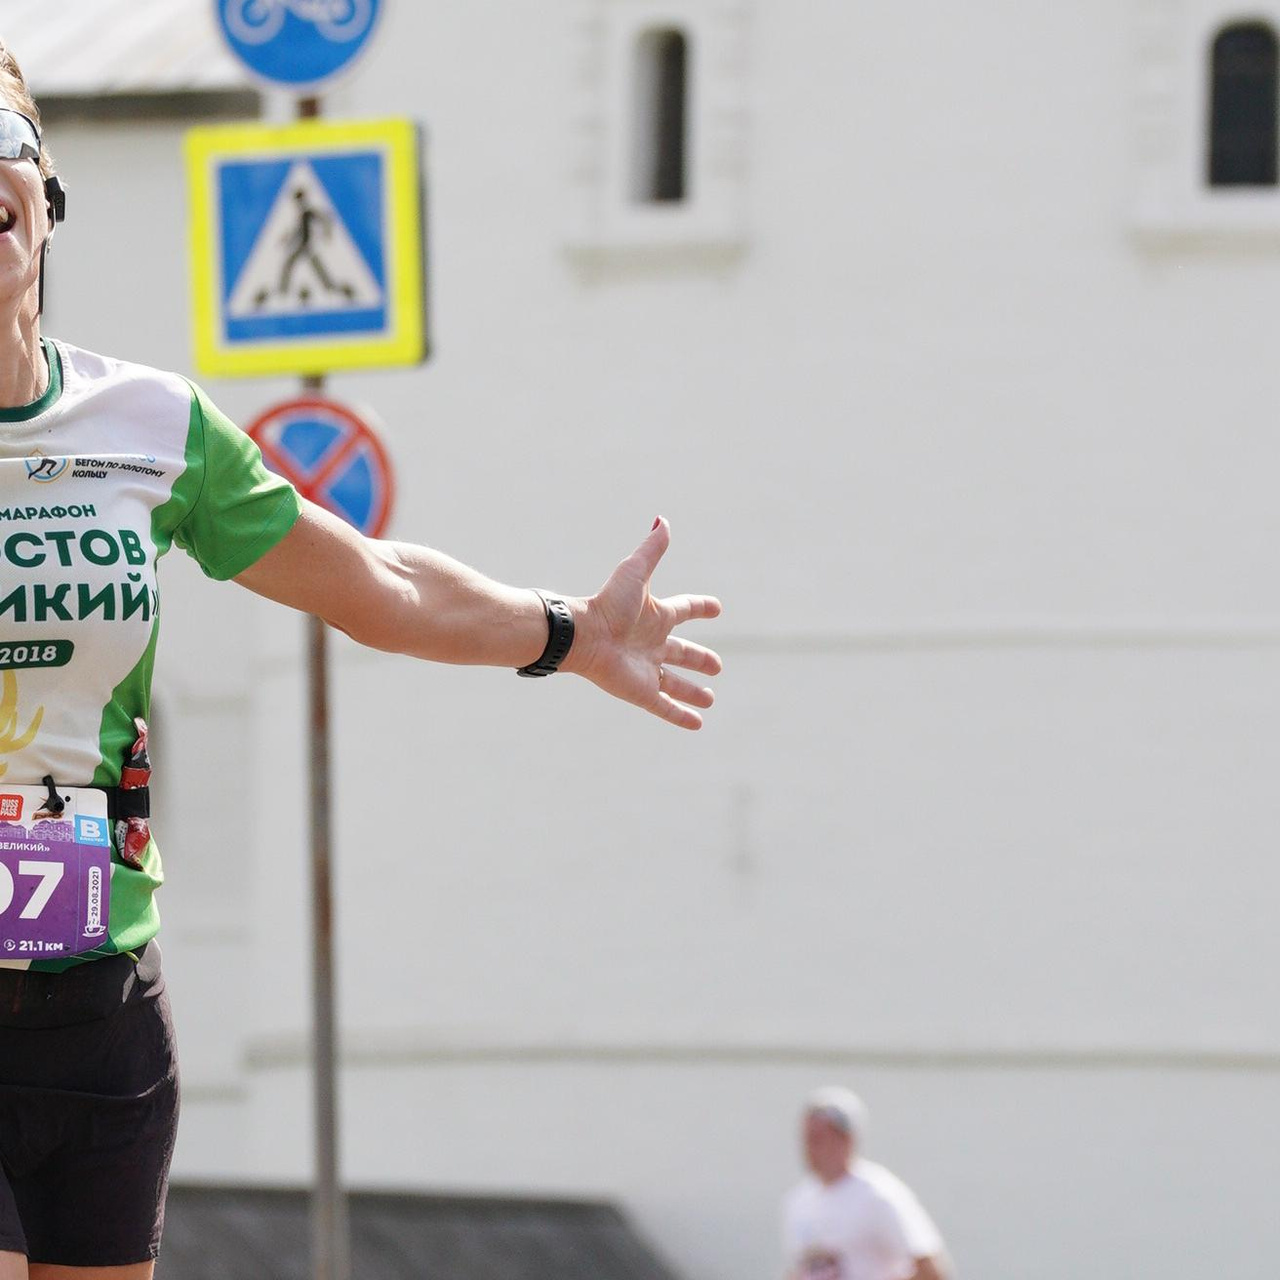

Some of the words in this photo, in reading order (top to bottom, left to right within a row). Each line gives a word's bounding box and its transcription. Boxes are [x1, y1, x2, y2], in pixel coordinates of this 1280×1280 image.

[74, 458, 105, 469] БЕГОМ
[72, 470, 108, 479] КОЛЬЦУ
[91, 870, 100, 917] 29.08.2021
[19, 940, 43, 951] 21.1
